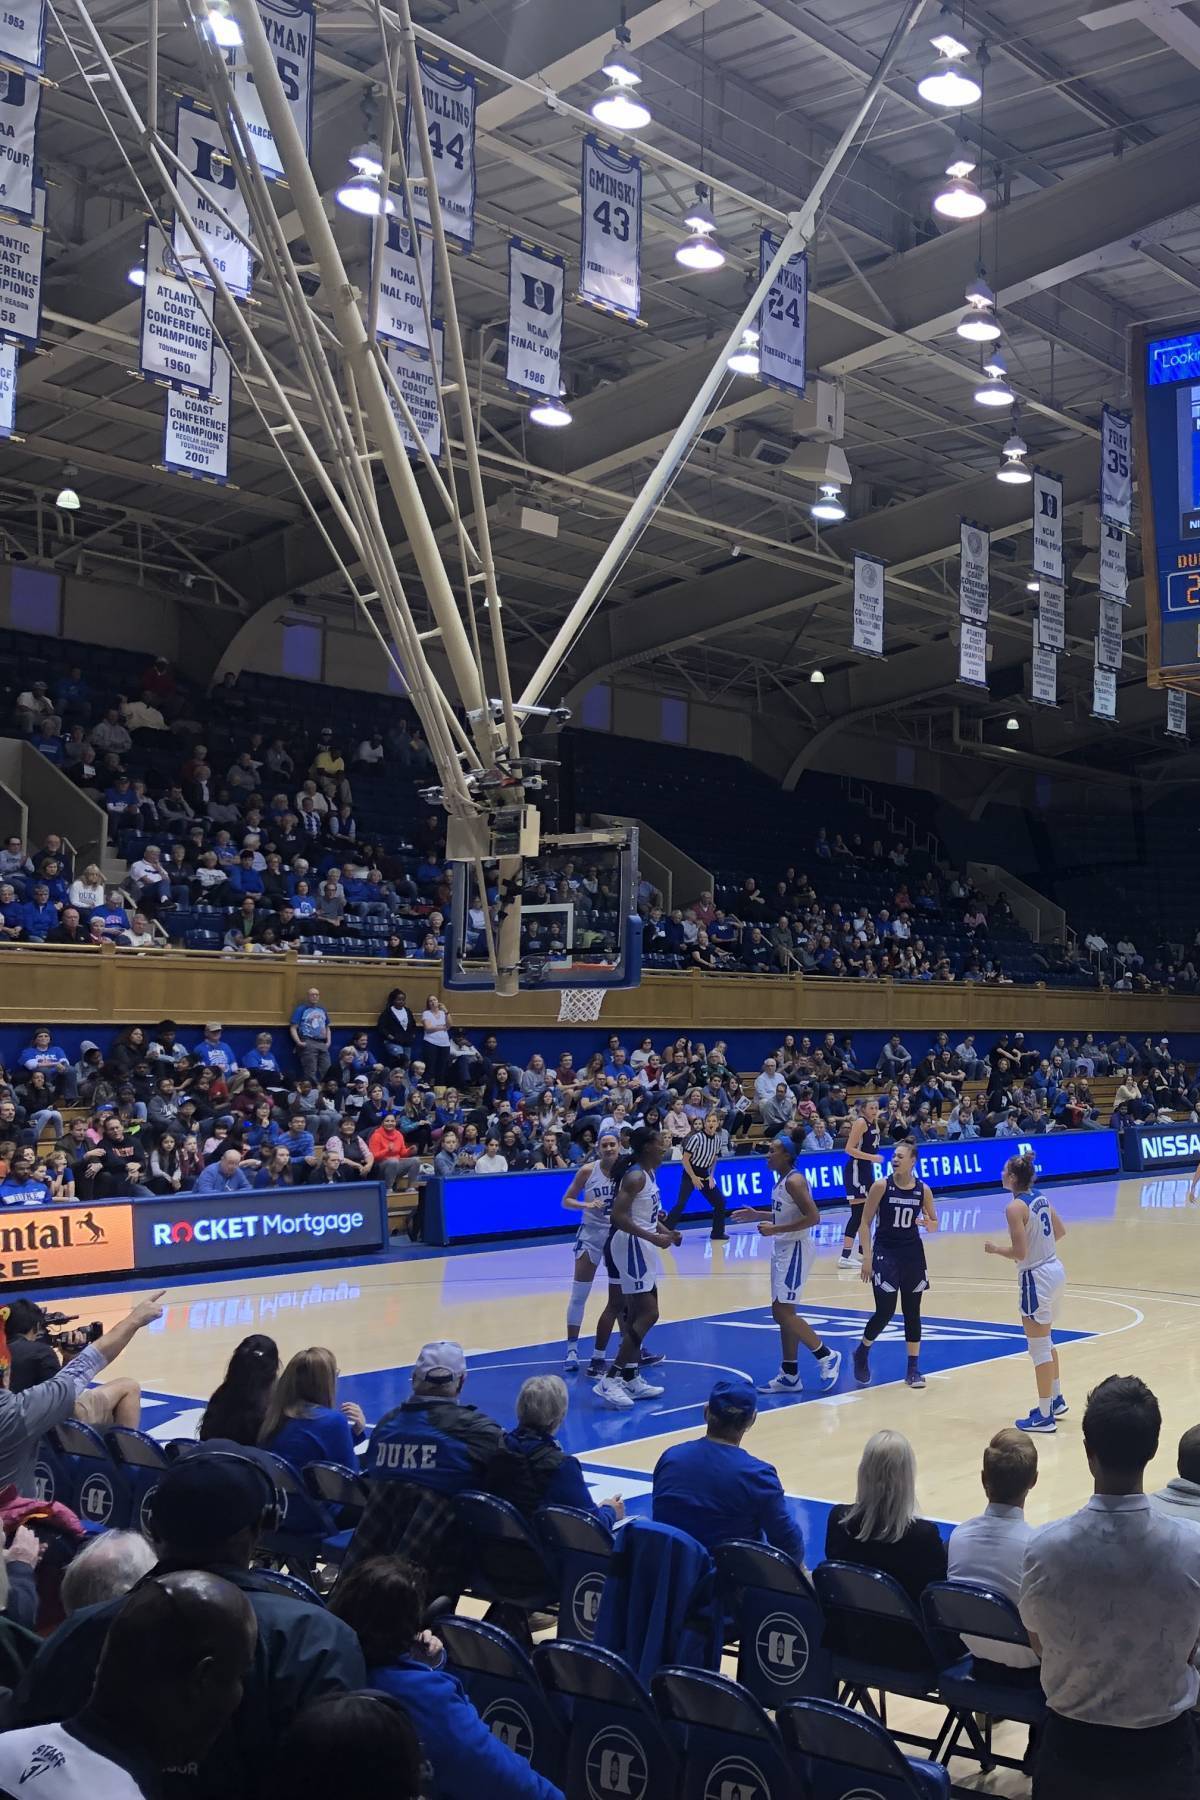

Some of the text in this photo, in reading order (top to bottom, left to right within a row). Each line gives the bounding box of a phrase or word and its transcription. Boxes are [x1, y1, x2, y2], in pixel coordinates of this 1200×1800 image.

[3, 12, 25, 31] 1952
[428, 121, 464, 170] 44
[589, 168, 636, 208] GMINSKI
[593, 200, 629, 242] 43
[390, 266, 416, 286] NCAA
[164, 301, 196, 320] COAST
[768, 287, 800, 328] 24
[147, 309, 211, 339] CONFERENCE
[391, 318, 414, 335] 1978
[526, 321, 549, 339] NCAA
[149, 324, 208, 351] CHAMPIONS
[511, 335, 537, 352] FINAL
[158, 343, 197, 360] TOURNAMENT
[164, 357, 191, 374] 1960
[397, 366, 434, 386] ATLANTIC
[524, 368, 545, 384] 1986
[402, 380, 427, 395] COAST
[185, 400, 214, 416] COAST
[170, 408, 227, 432] CONFERENCE
[172, 421, 224, 443] CHAMPIONS
[185, 451, 210, 465] 2001
[1107, 450, 1128, 478] 35
[721, 1152, 983, 1197] UKE BAKETBALL
[892, 1206, 914, 1228] 10
[1040, 1211, 1052, 1237] 3
[153, 1210, 364, 1247] ROCKET Mortgage
[376, 1442, 437, 1469] DUKE
[32, 1744, 66, 1769] STAFF
